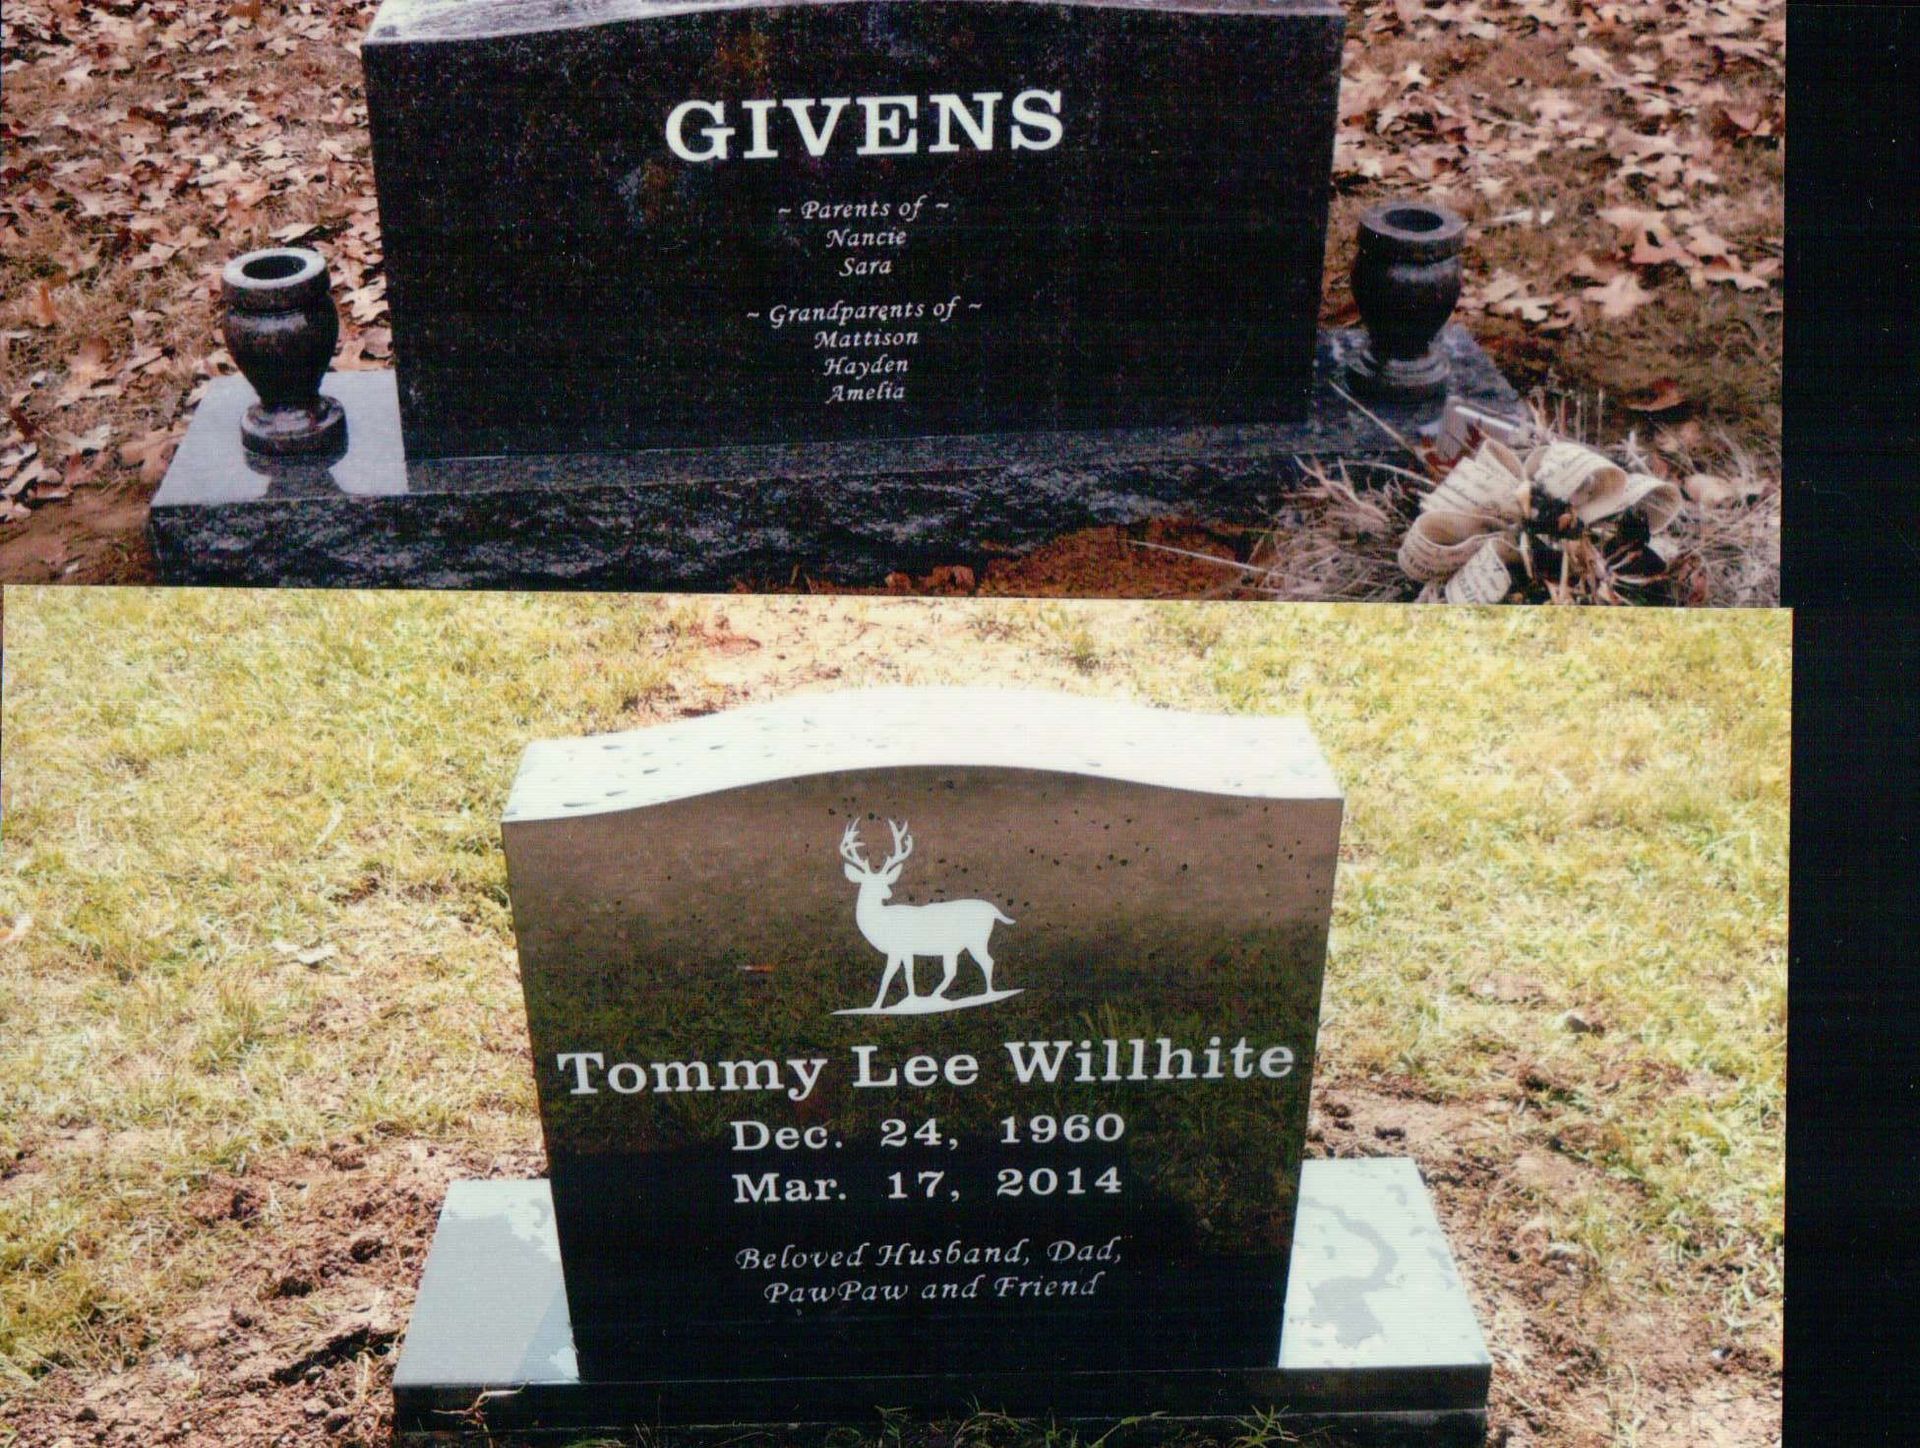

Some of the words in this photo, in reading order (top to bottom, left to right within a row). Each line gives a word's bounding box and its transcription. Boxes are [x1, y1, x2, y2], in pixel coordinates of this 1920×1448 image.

[665, 89, 1064, 163] GIVENS
[800, 200, 891, 220] Parents
[898, 194, 928, 223] of
[825, 227, 907, 248] Nancie
[838, 257, 892, 277] Sara
[769, 299, 925, 329] Grandparents
[932, 295, 961, 323] of
[814, 330, 918, 350] Mattison
[823, 354, 908, 379] Hayden
[825, 382, 905, 404] Amelia
[556, 1052, 828, 1101] Tommy
[850, 1045, 979, 1088] Lee
[1003, 1036, 1295, 1083] Willhite
[729, 1120, 843, 1151] Dec.
[880, 1117, 958, 1150] 24,
[1001, 1113, 1125, 1144] 1960
[731, 1172, 846, 1203] Mar.
[888, 1170, 960, 1202] 17,
[996, 1166, 1122, 1197] 2014
[736, 1242, 869, 1270] Beloved
[876, 1238, 1030, 1267] Husband,
[1047, 1235, 1122, 1263] Dad,
[764, 1280, 909, 1304] PawPaw
[921, 1273, 986, 1299] and
[994, 1270, 1106, 1297] Friend
